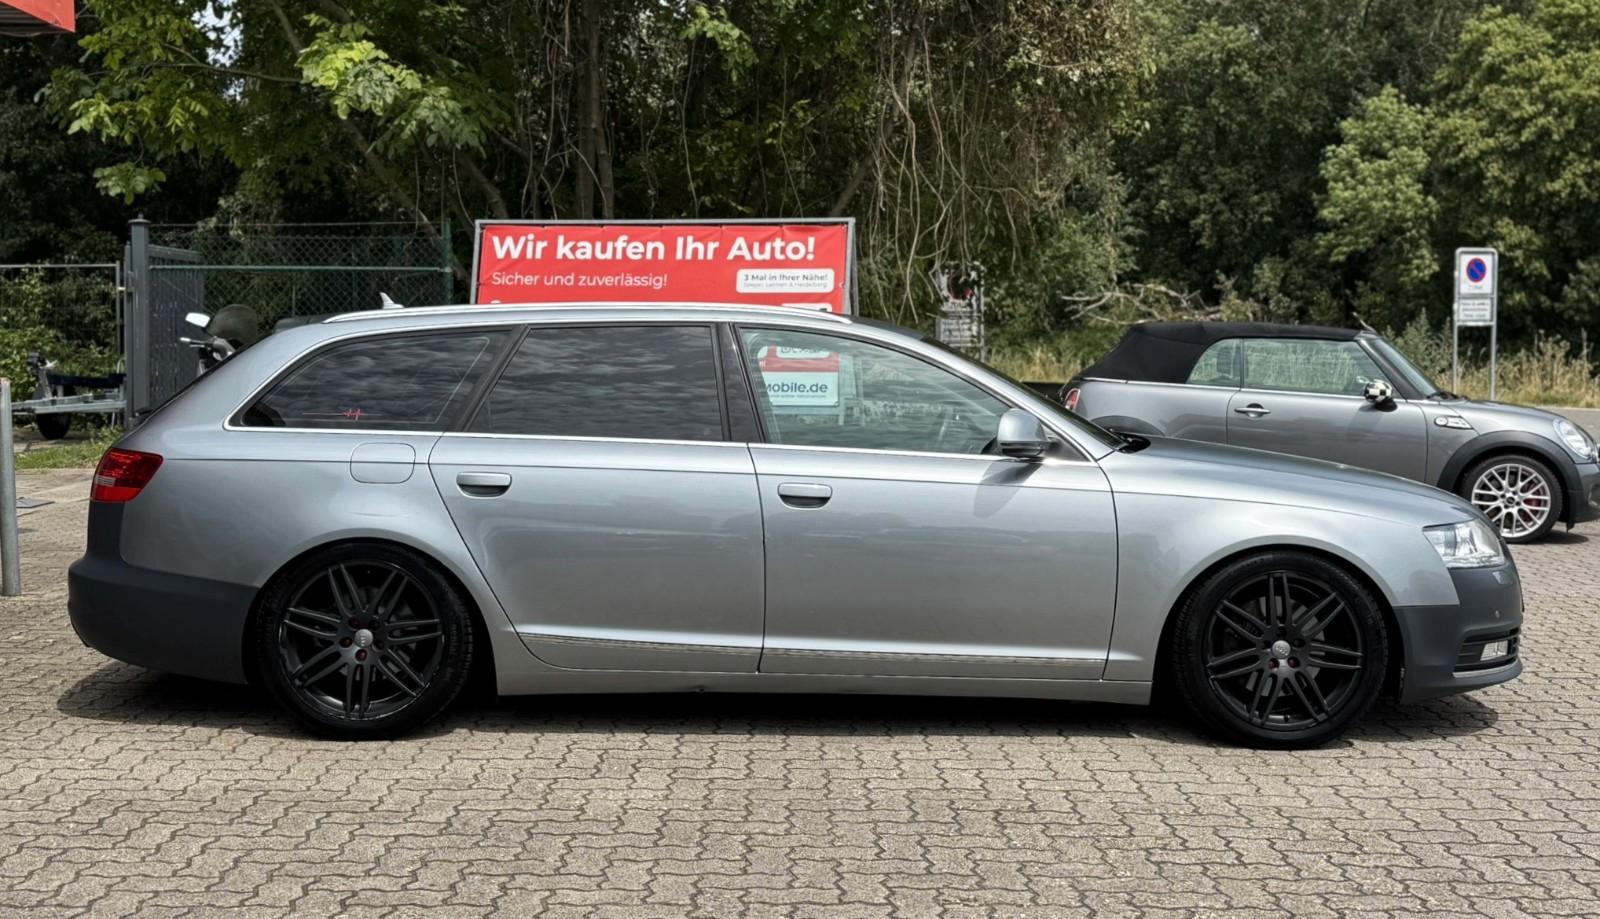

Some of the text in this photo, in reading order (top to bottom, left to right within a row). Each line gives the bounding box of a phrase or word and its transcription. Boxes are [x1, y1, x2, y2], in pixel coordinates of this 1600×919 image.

[492, 233, 816, 261] Wir kaufen Ihr Auto!
[491, 271, 668, 290] Sicher und zuverlässig!
[743, 273, 750, 282] 3
[768, 273, 777, 281] in
